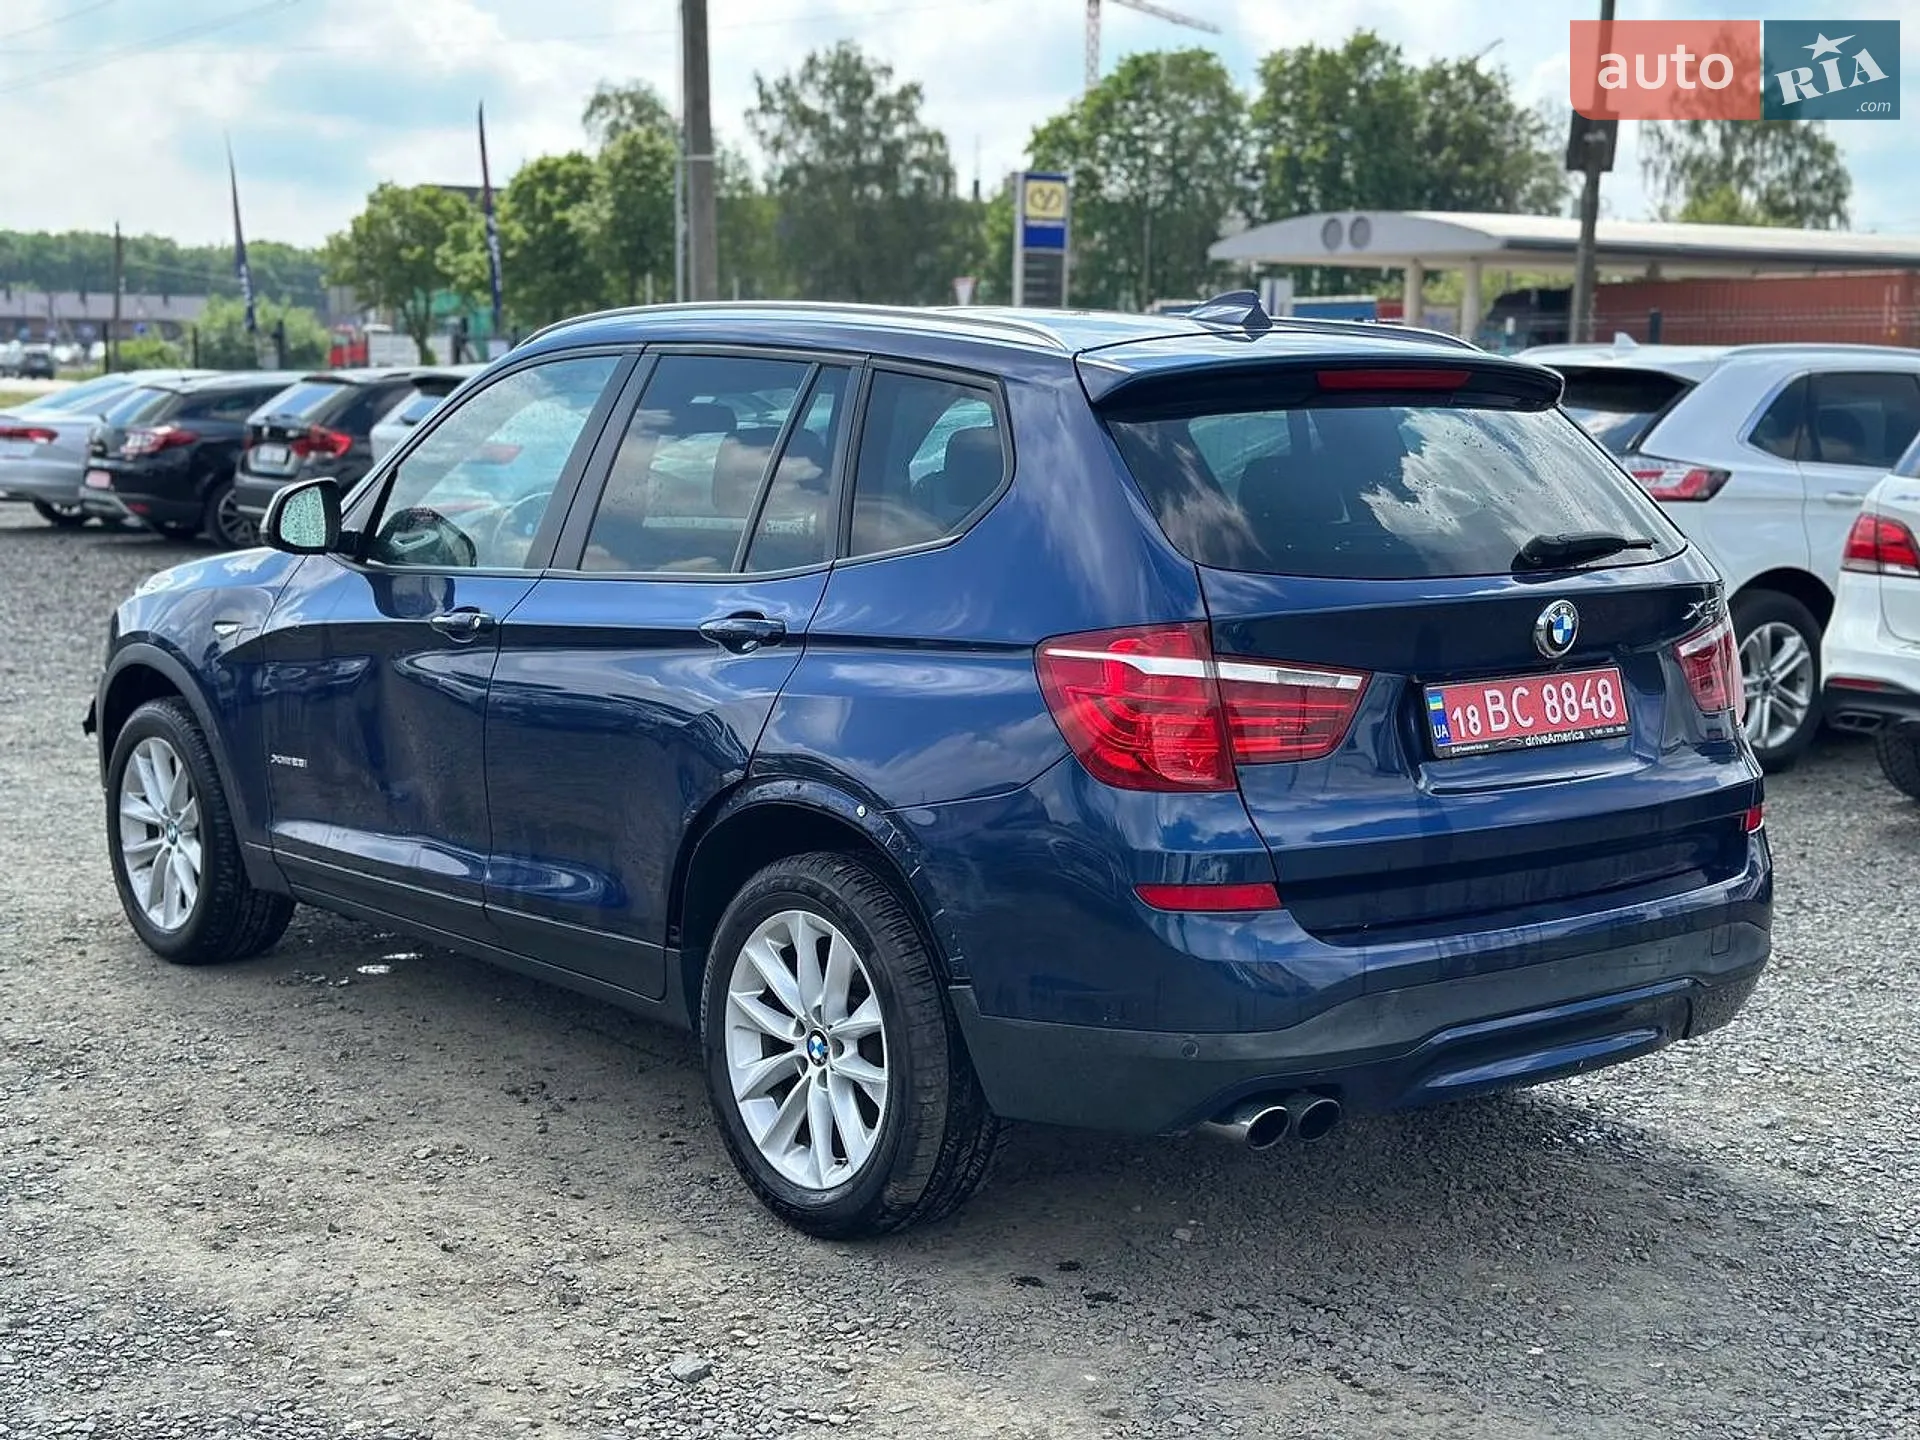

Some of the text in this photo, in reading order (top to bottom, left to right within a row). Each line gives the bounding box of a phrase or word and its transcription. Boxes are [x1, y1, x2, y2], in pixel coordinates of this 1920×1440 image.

[1452, 678, 1616, 738] 18 BC 8848
[1433, 725, 1449, 739] UA
